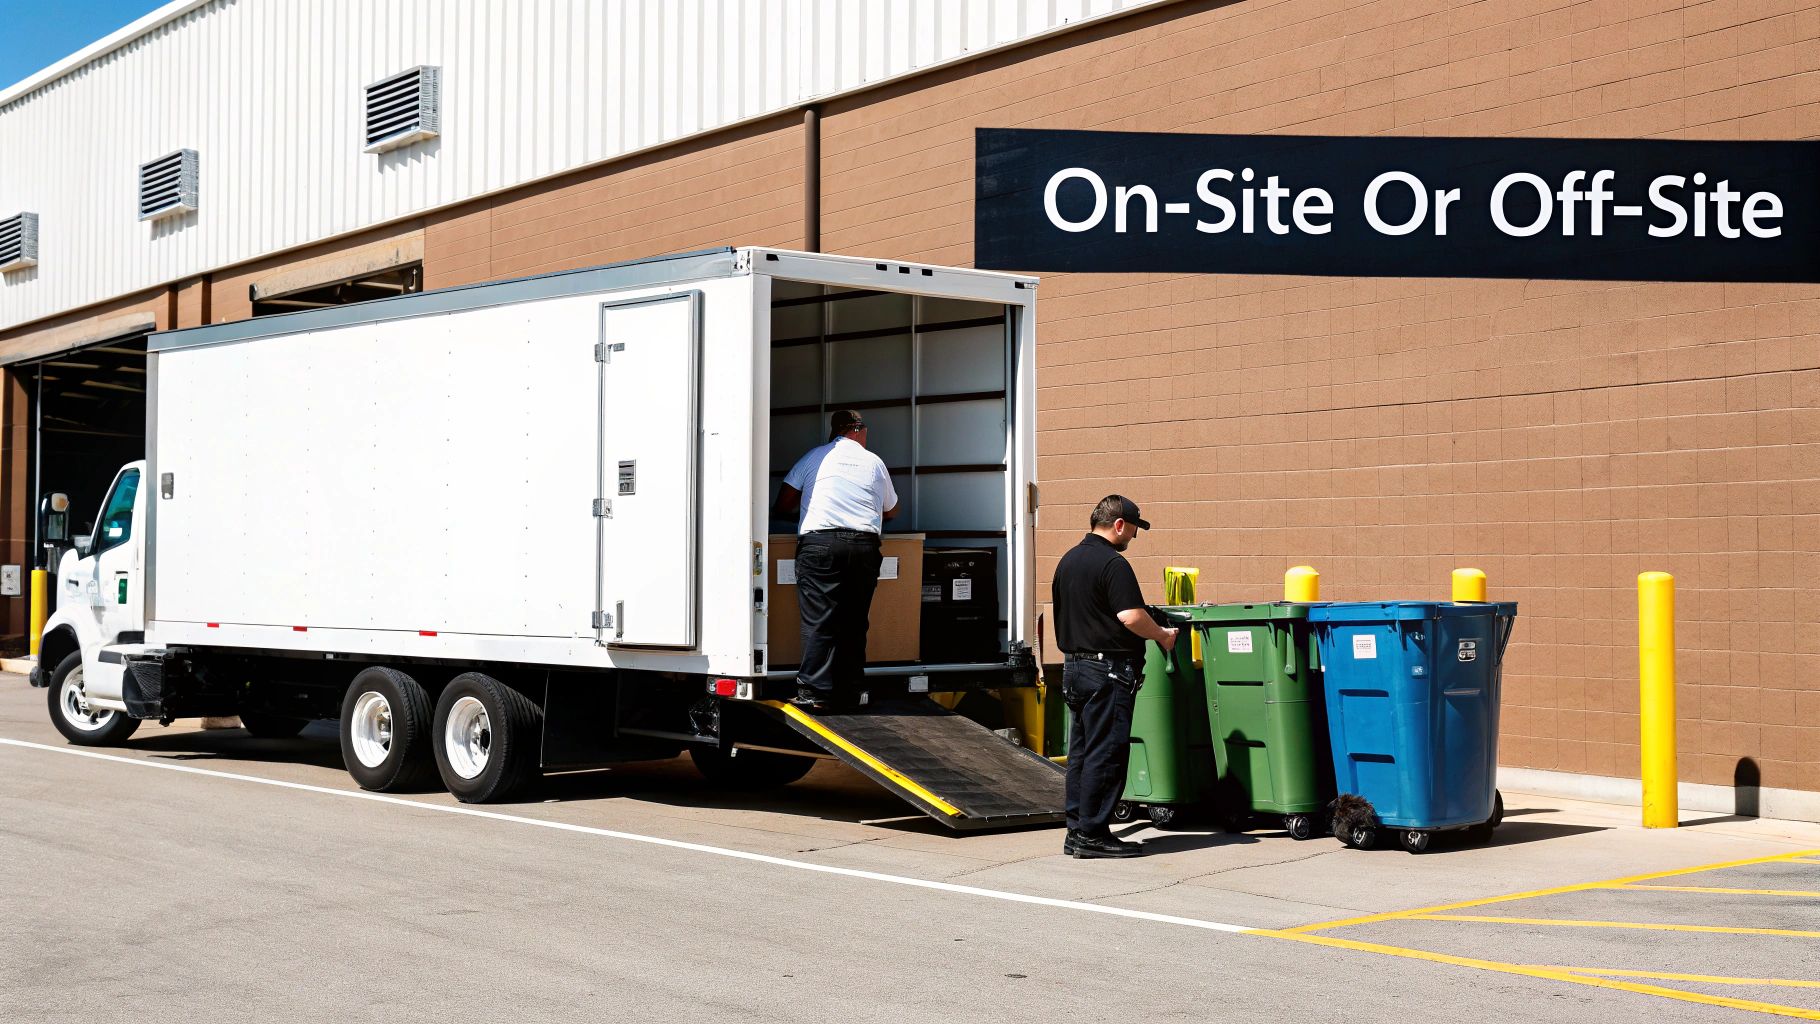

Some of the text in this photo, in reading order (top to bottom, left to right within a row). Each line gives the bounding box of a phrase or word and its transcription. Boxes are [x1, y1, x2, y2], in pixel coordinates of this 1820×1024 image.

[1043, 167, 1784, 239] On-Site Or Off-Site
